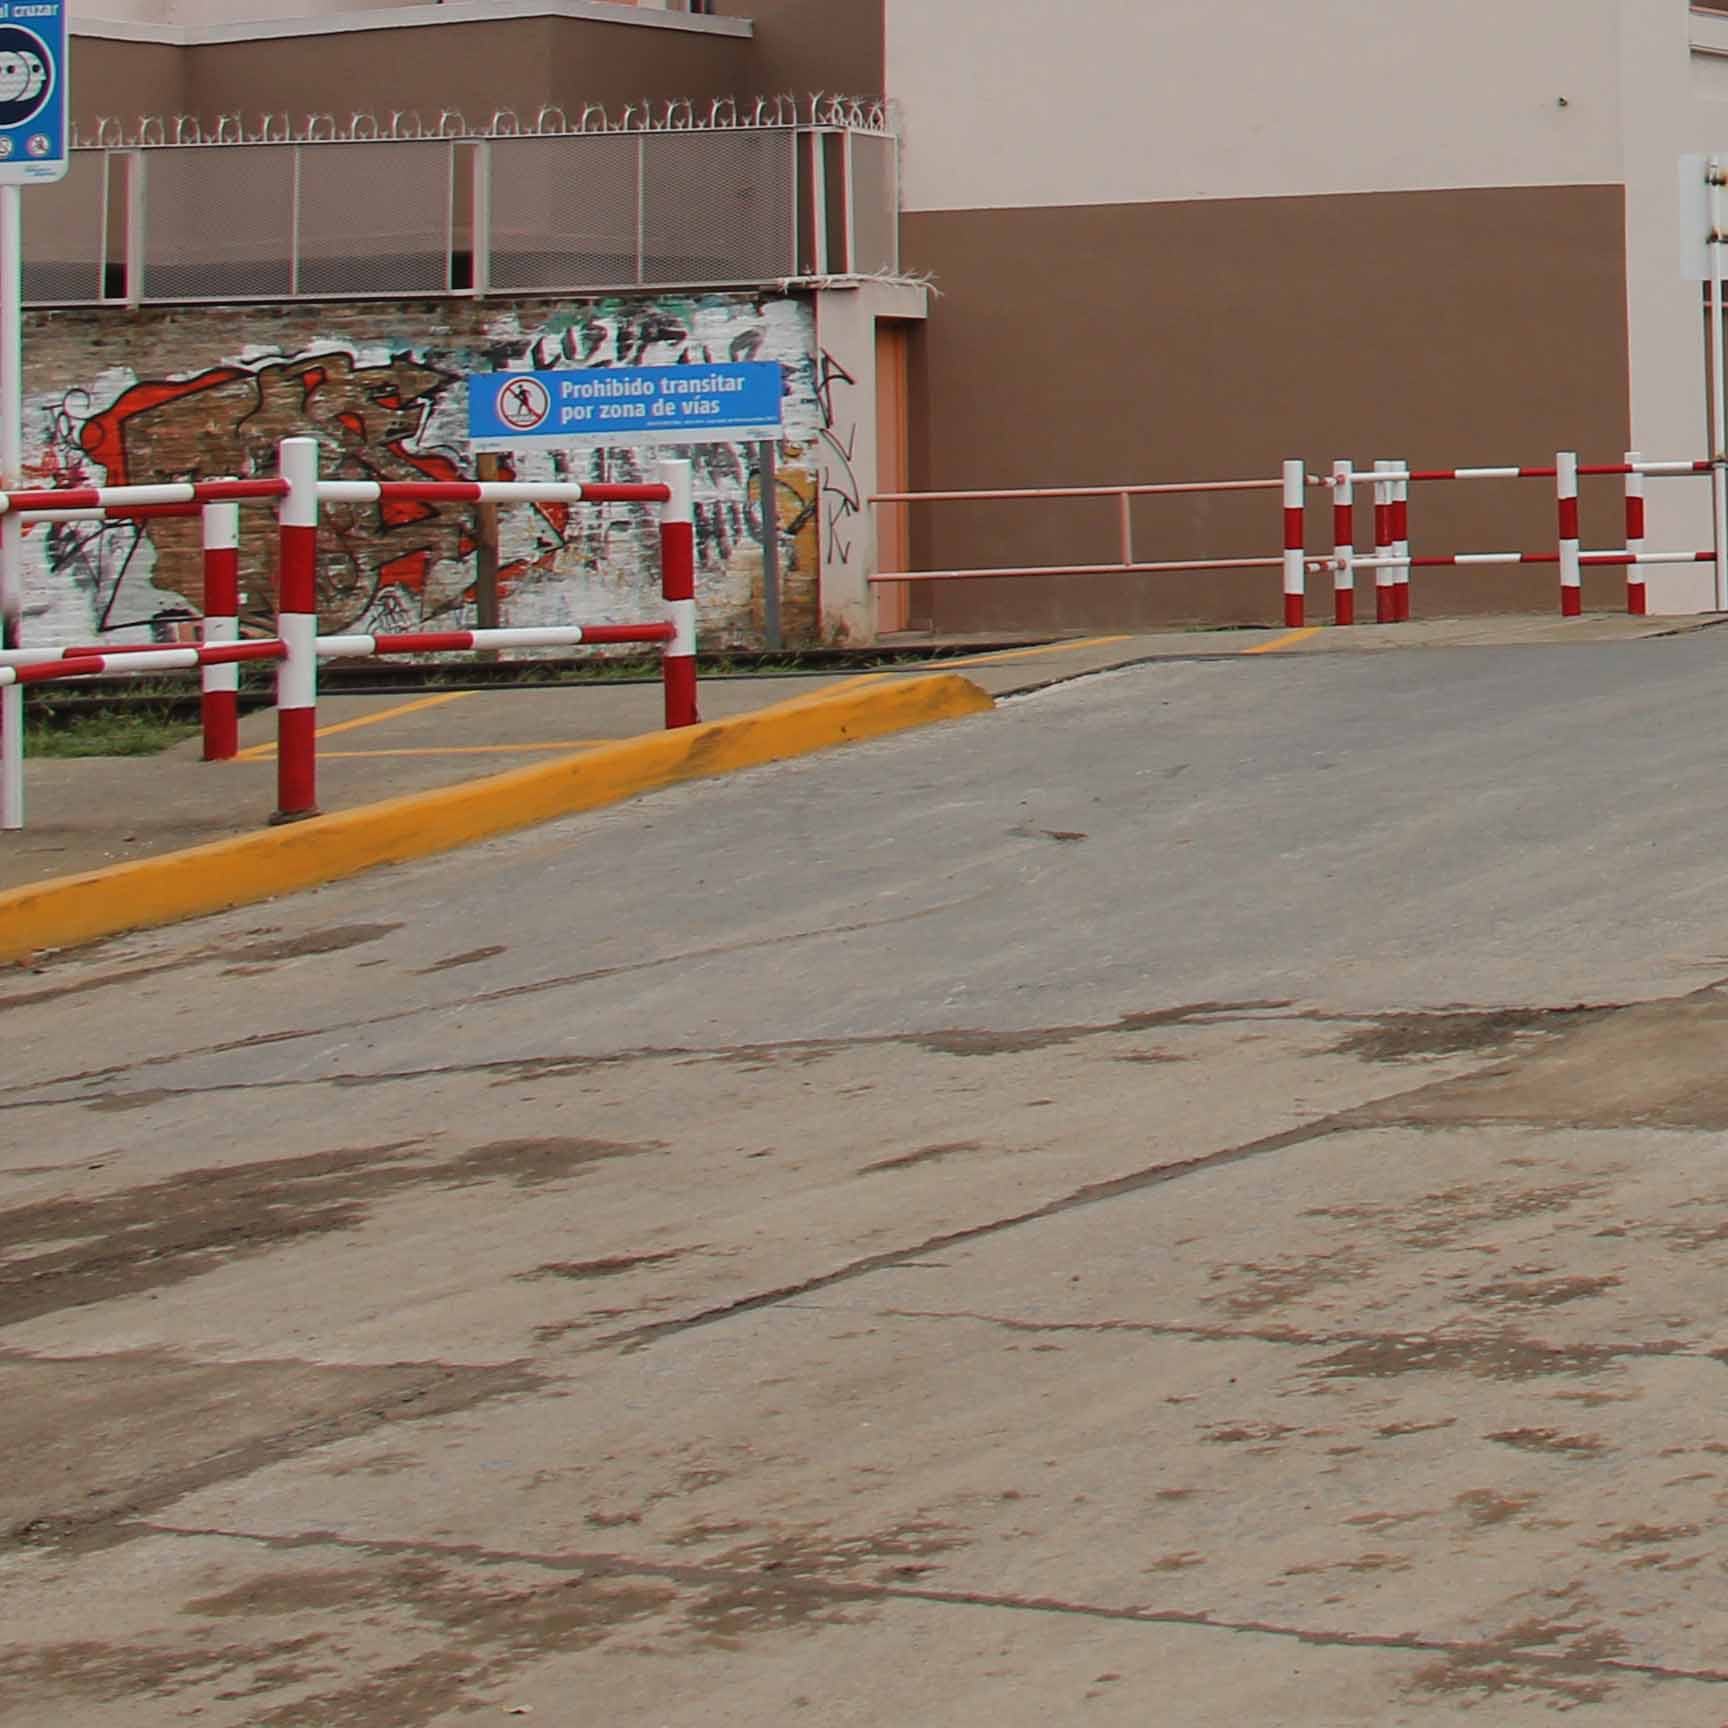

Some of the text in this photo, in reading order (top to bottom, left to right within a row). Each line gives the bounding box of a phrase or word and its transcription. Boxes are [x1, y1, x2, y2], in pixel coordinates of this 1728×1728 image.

[560, 373, 745, 400] Prohibido transitar
[560, 395, 721, 425] por zona de vías
